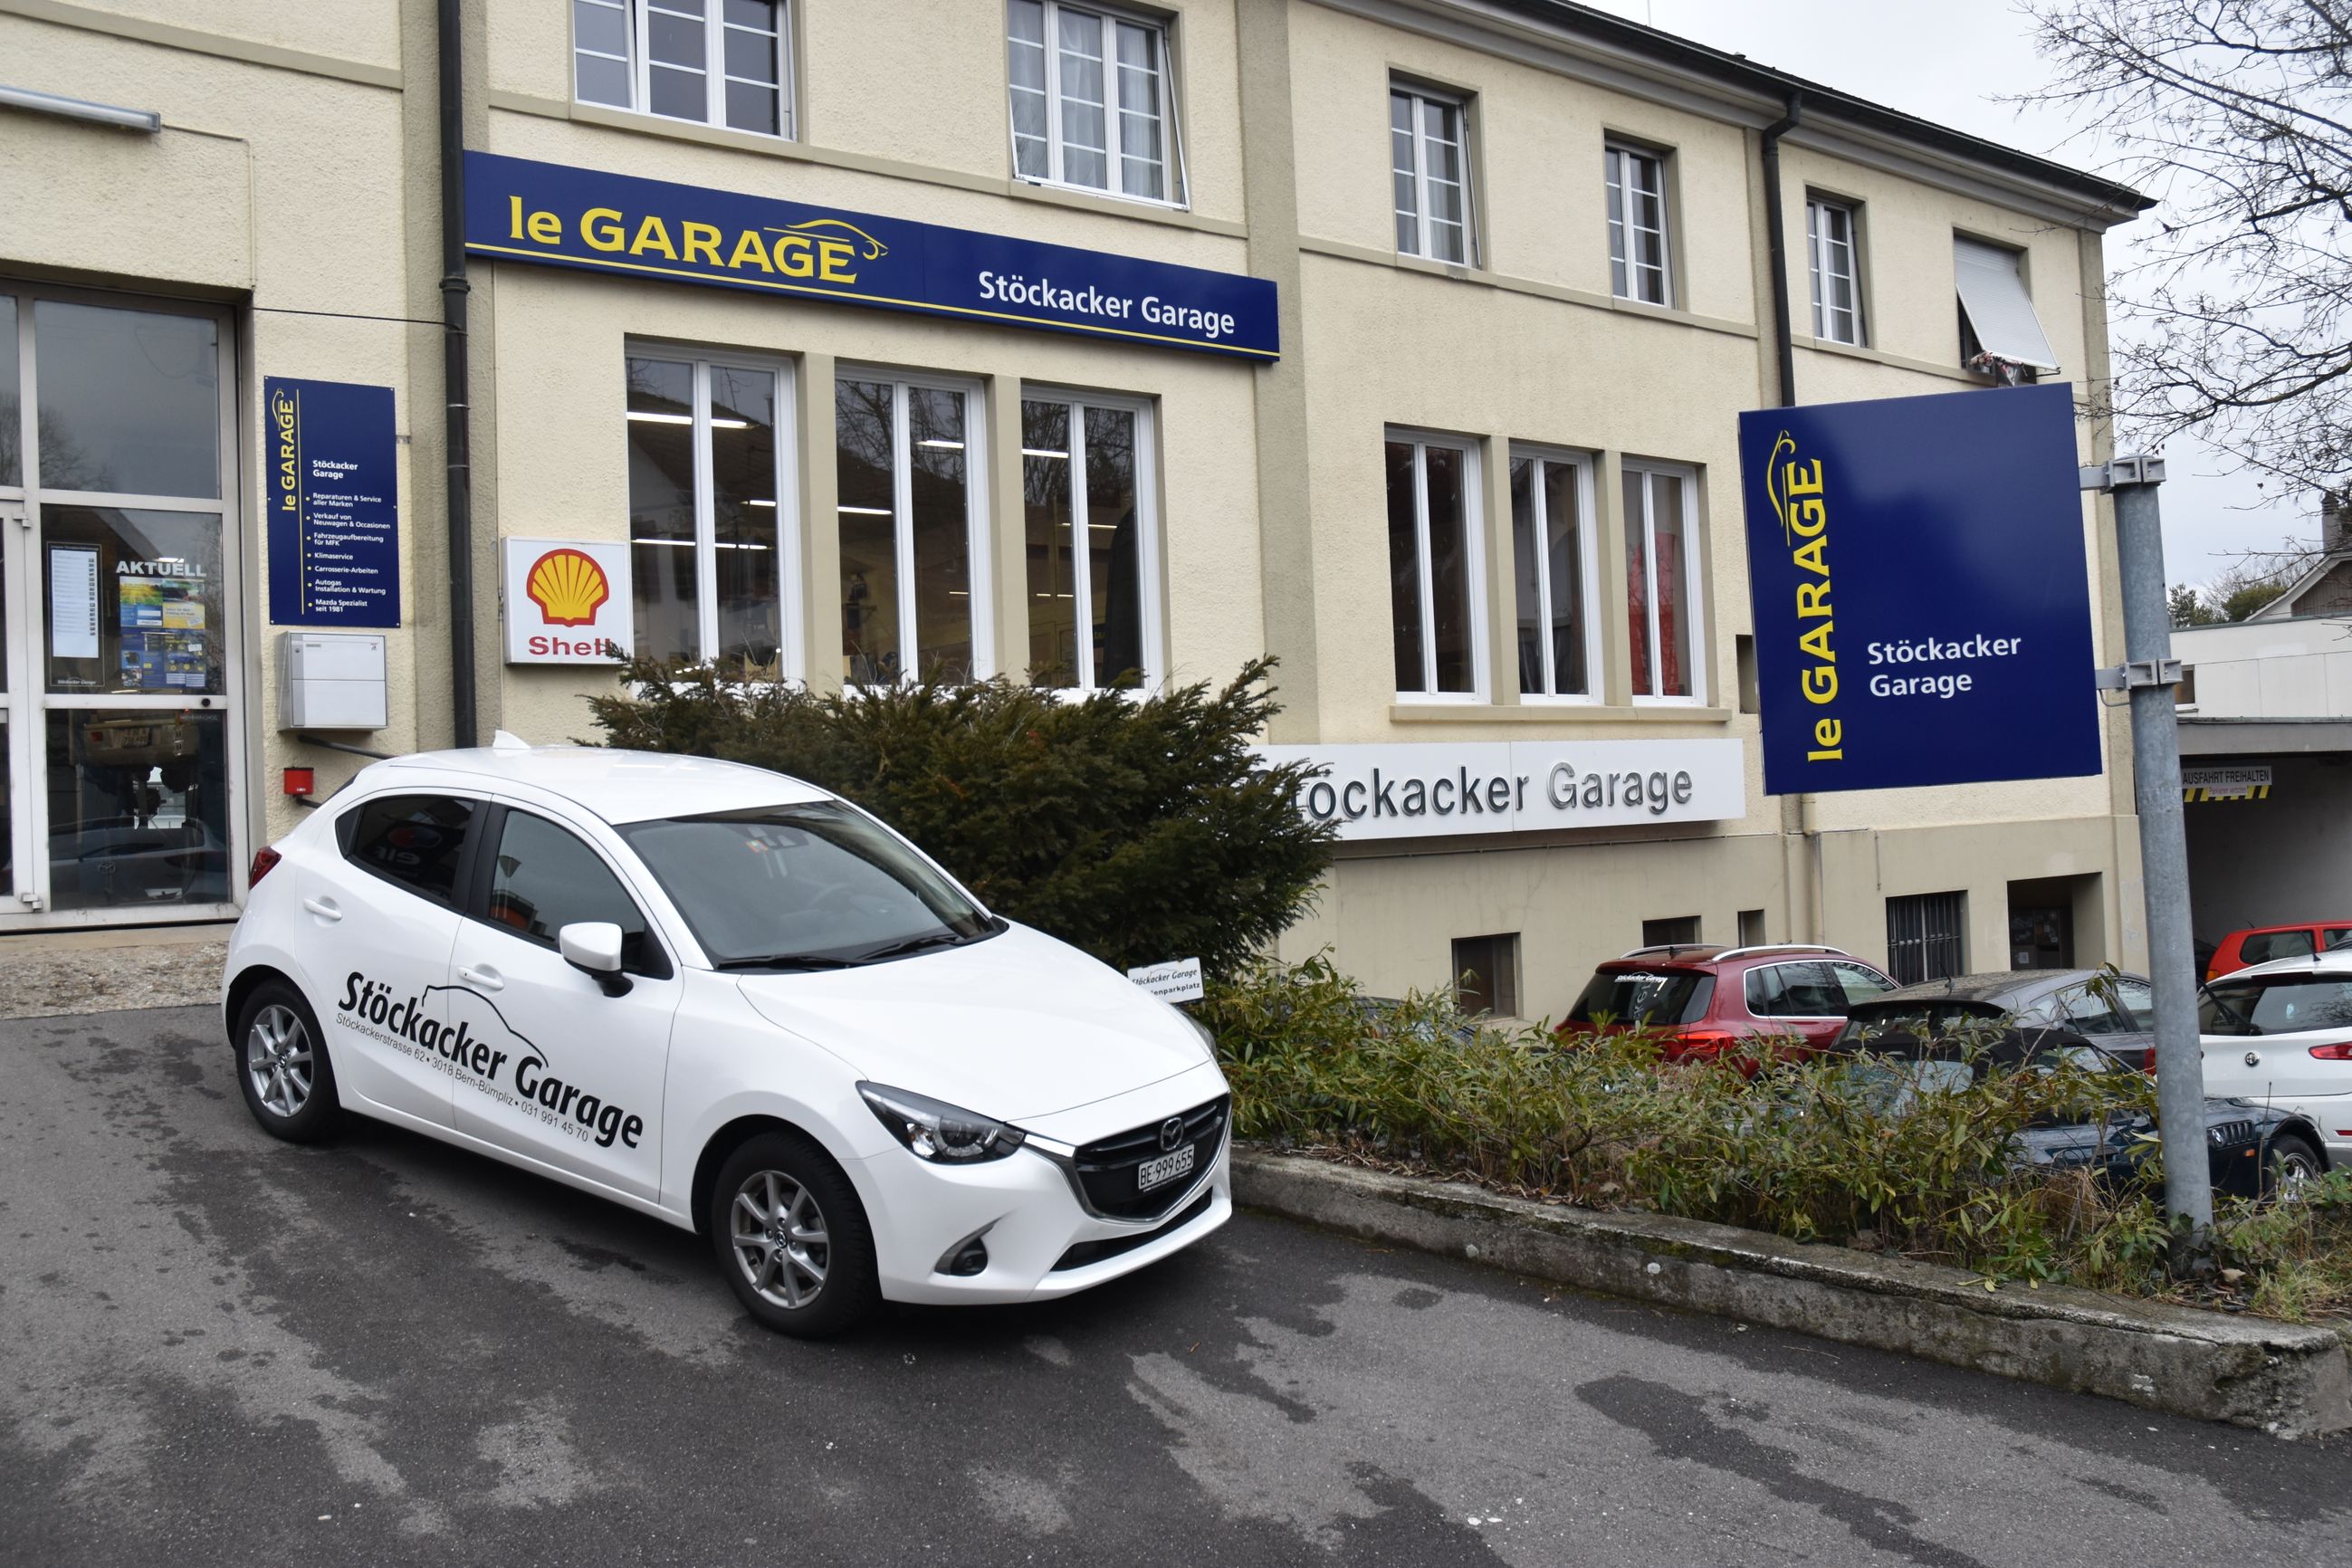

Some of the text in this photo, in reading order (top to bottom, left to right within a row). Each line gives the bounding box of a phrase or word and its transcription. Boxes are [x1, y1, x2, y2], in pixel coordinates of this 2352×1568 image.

[510, 196, 857, 284] le GARAGE
[979, 271, 1236, 339] Stöckacker Garage
[280, 399, 296, 512] le GARAGE
[312, 459, 359, 471] Stöckacker
[312, 469, 344, 480] Garage
[312, 492, 352, 502] Reparaturen
[360, 495, 382, 503] Service
[329, 500, 353, 508] Marken
[313, 512, 339, 521] Verkauf
[313, 519, 348, 528] Neuwagen
[355, 521, 391, 530] Occasionen
[313, 532, 384, 543] Fahrzeugaufbereitung
[314, 552, 354, 560] Klimaservice
[116, 560, 207, 577] AKTUELL
[314, 565, 378, 574] Carrosserie-Arbeiten
[314, 578, 342, 587] Autogas
[358, 587, 387, 596] Wartung
[339, 599, 368, 607] Spezialist
[1786, 458, 1843, 762] le GARAGE
[529, 636, 612, 656] Shell
[1868, 634, 2022, 664] Stöckacker
[1869, 673, 1973, 699] Garage
[2183, 770, 2270, 785] AUSFAHRT FREIHALTEN
[1251, 766, 1694, 822] öckacker Garage
[1171, 969, 1198, 980] Garage
[1151, 982, 1200, 996] enparkplatz
[338, 970, 644, 1149] Stöckacker Garage
[336, 1012, 589, 1143] Stöckackerstrasse 62 3018 Bern-Bümpliz 031 991 45 70
